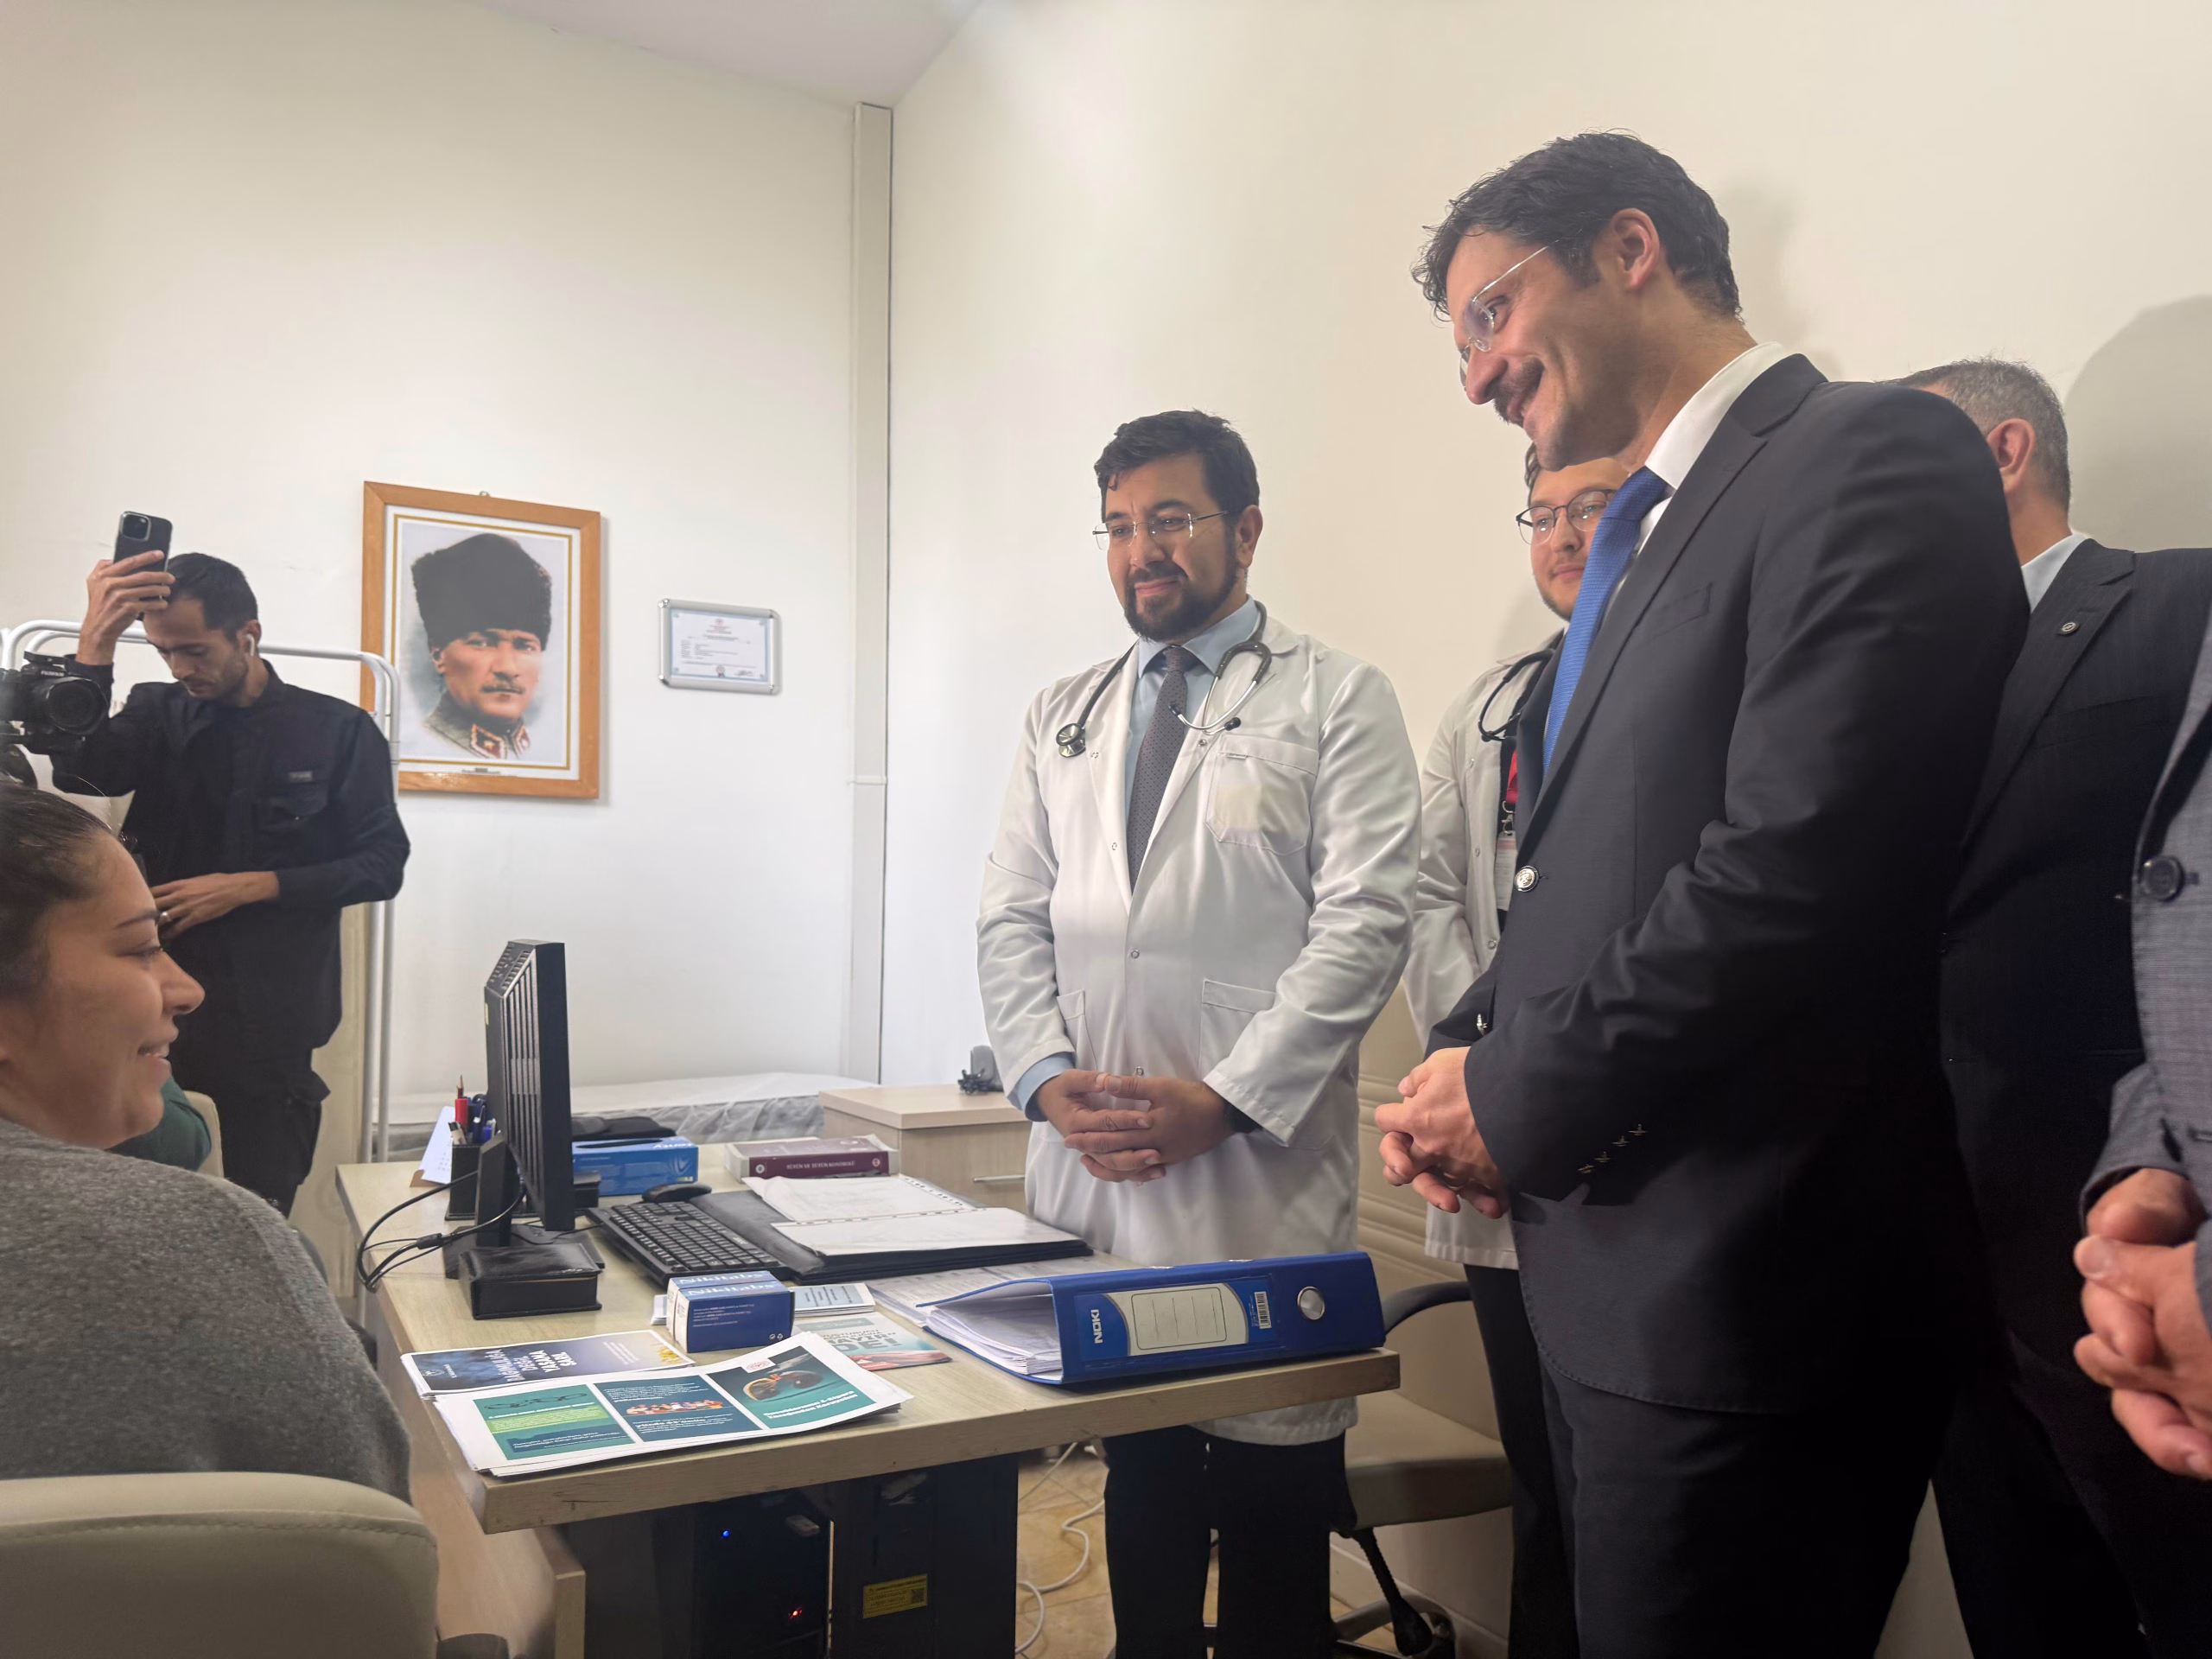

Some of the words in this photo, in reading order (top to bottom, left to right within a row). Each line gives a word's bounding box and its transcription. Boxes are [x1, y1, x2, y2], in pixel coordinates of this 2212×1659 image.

[679, 1273, 763, 1284] Nikitabs
[688, 1284, 775, 1295] Nikitabs
[1090, 1309, 1103, 1344] NOKI
[529, 1350, 561, 1373] YAŞAMA
